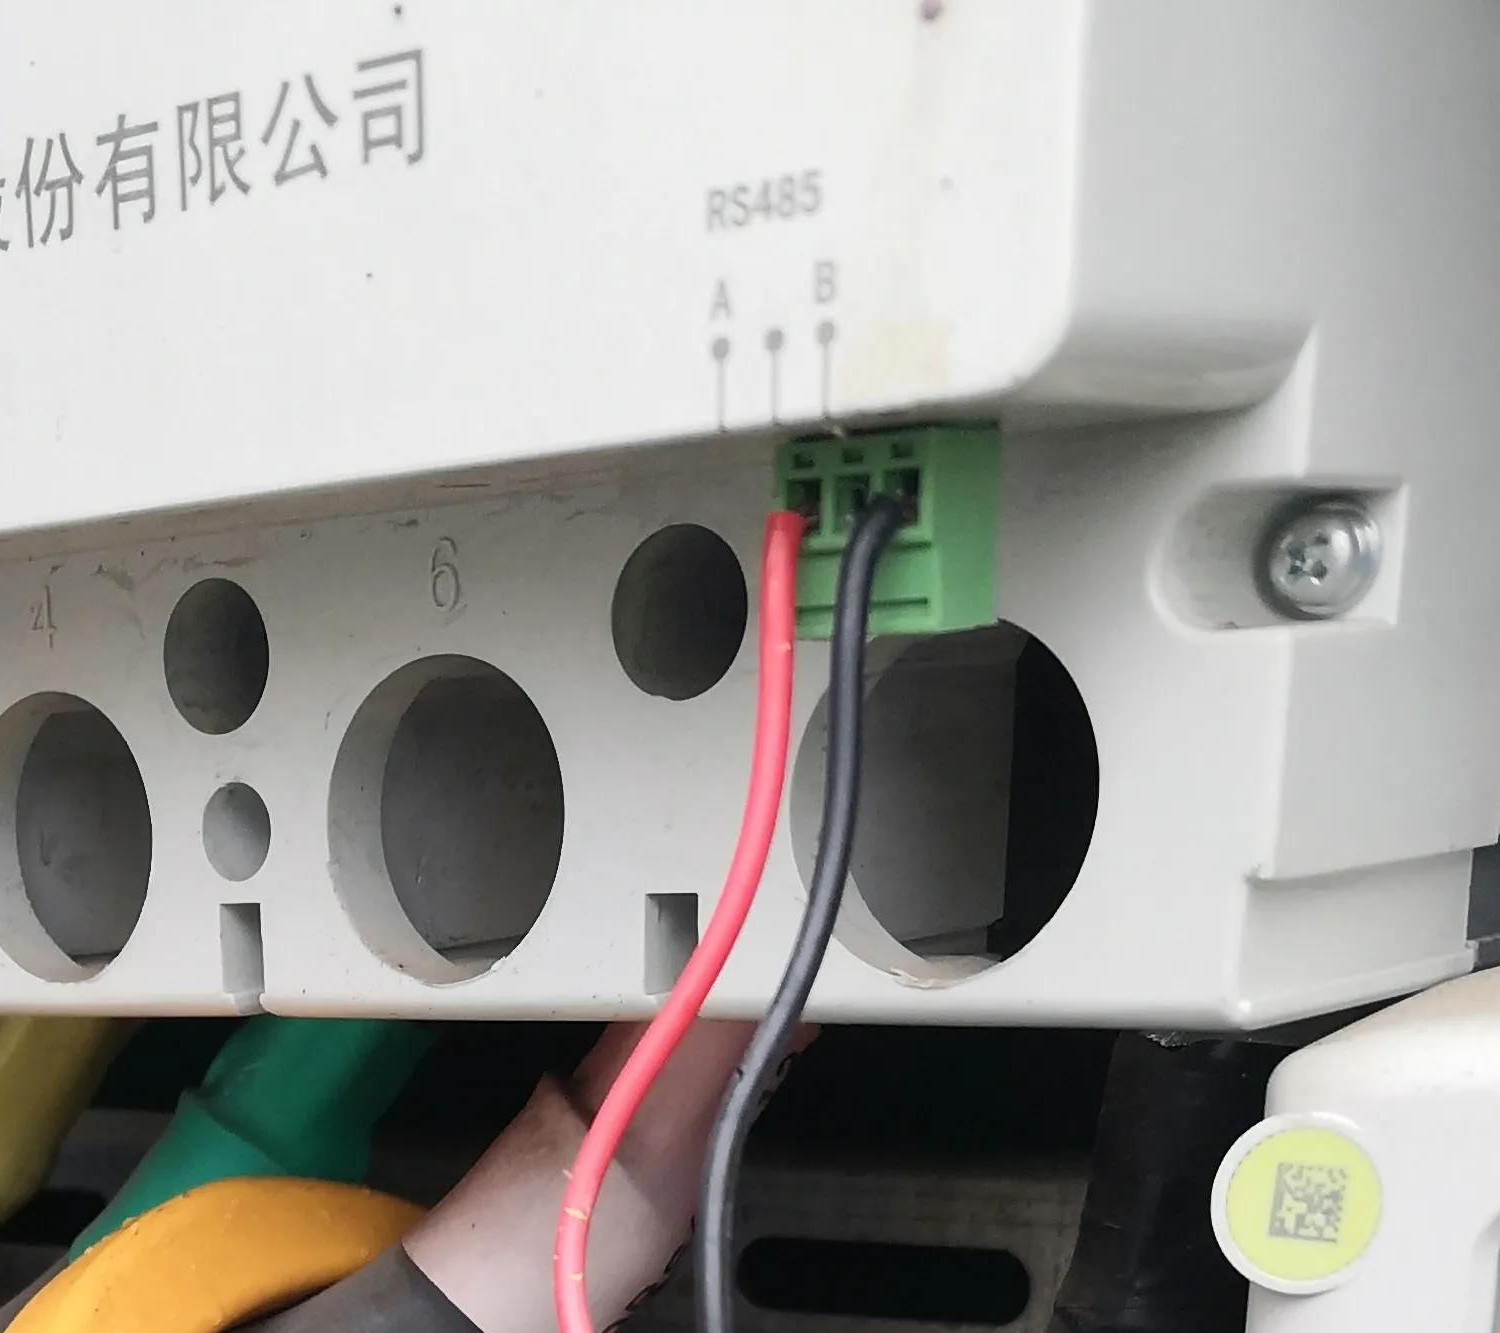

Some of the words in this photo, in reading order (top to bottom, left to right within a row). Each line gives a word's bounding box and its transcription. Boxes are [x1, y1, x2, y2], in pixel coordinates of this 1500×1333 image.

[706, 169, 824, 232] RS485
[711, 280, 733, 321] A
[813, 260, 836, 305] B
[430, 536, 464, 615] 6
